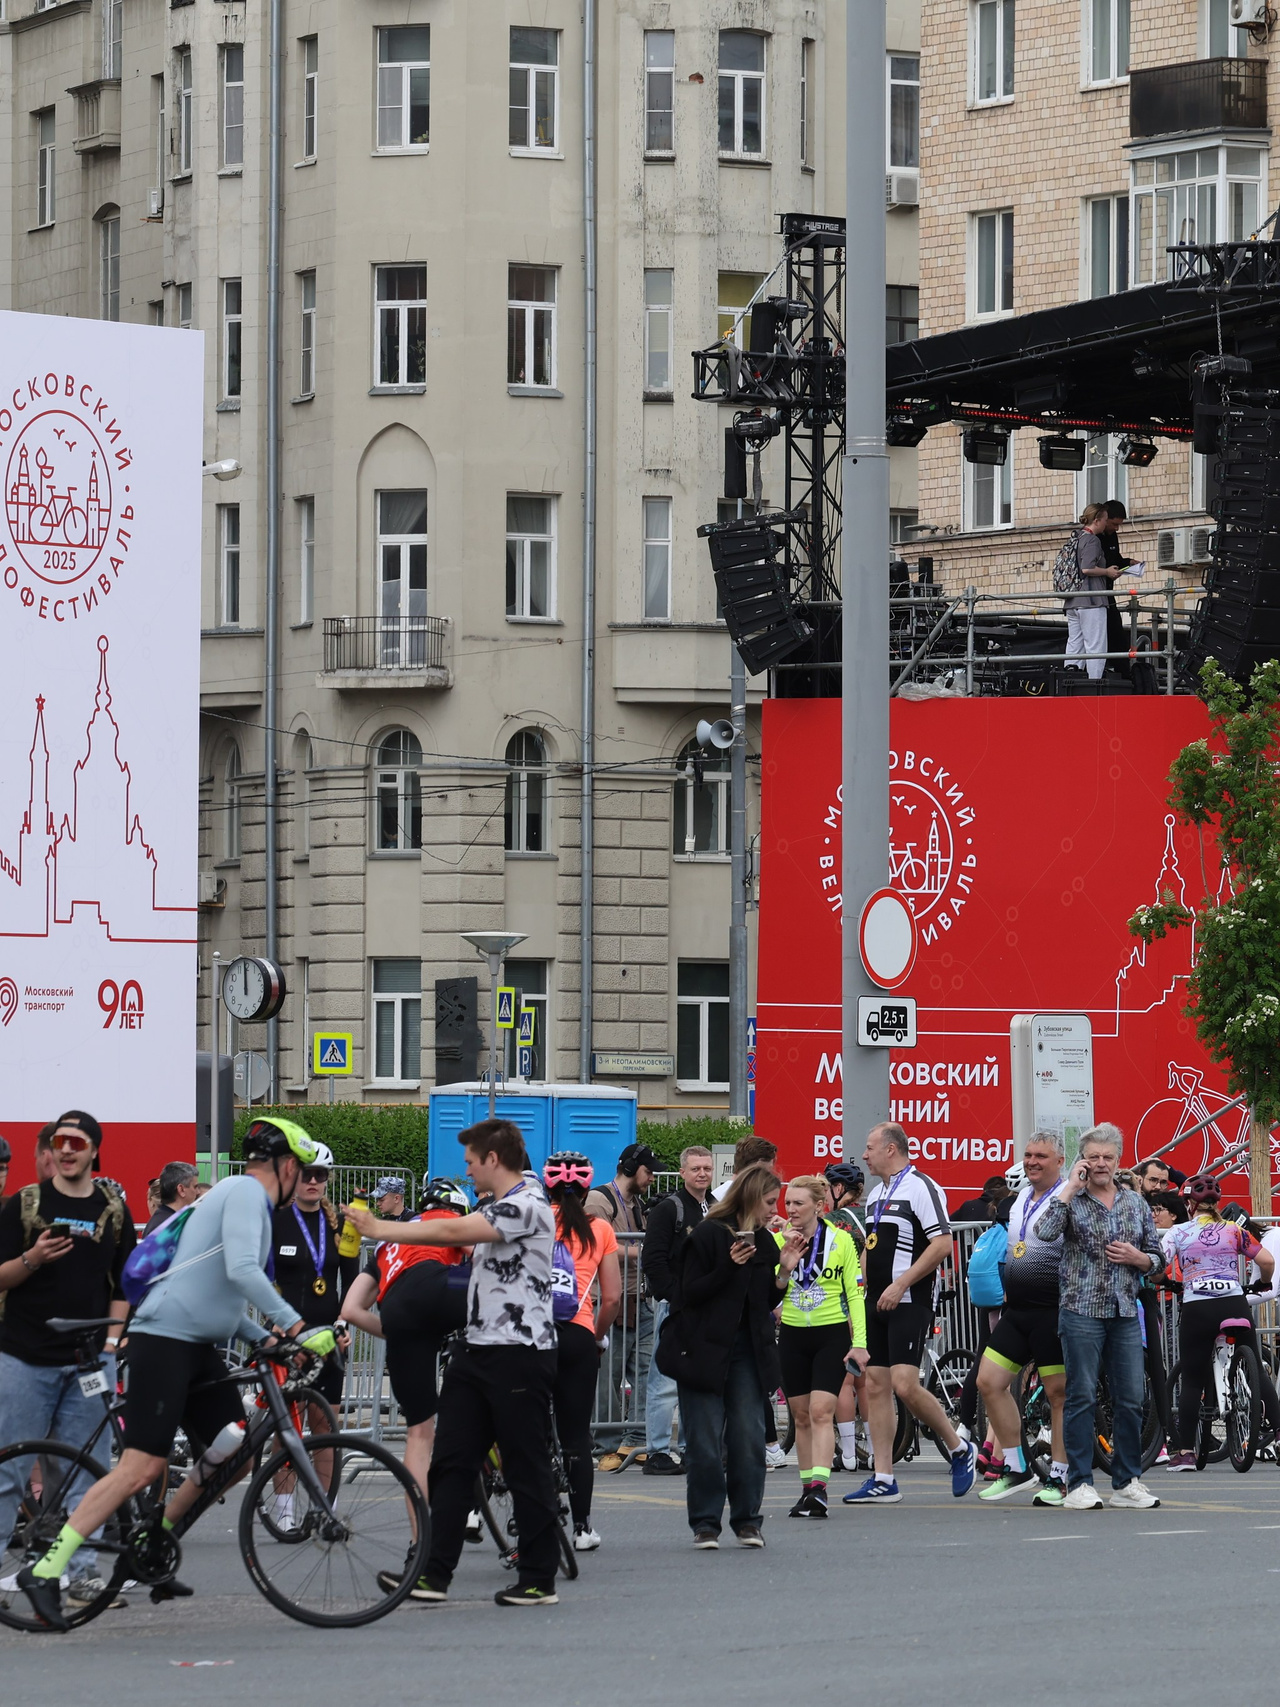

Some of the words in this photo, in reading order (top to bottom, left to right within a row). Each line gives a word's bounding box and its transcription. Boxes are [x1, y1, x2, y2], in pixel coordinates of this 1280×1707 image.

[0, 372, 133, 471] ОСКОВСКИЙ
[44, 550, 76, 571] 2025
[824, 750, 976, 829] МОВСКИЙ
[819, 854, 977, 946] ВЕЛИВАЛЬ
[24, 986, 74, 998] Московский
[24, 1002, 65, 1012] транспорт
[119, 1012, 144, 1030] ЛЕТ
[883, 1010, 897, 1026] 2,5
[611, 1057, 672, 1066] НЕОПАЛИМОВСКИЙ
[815, 1053, 999, 1087] Мовский
[814, 1092, 950, 1123] вений
[814, 1134, 1014, 1162] веестивал
[1198, 1280, 1231, 1291] 2101
